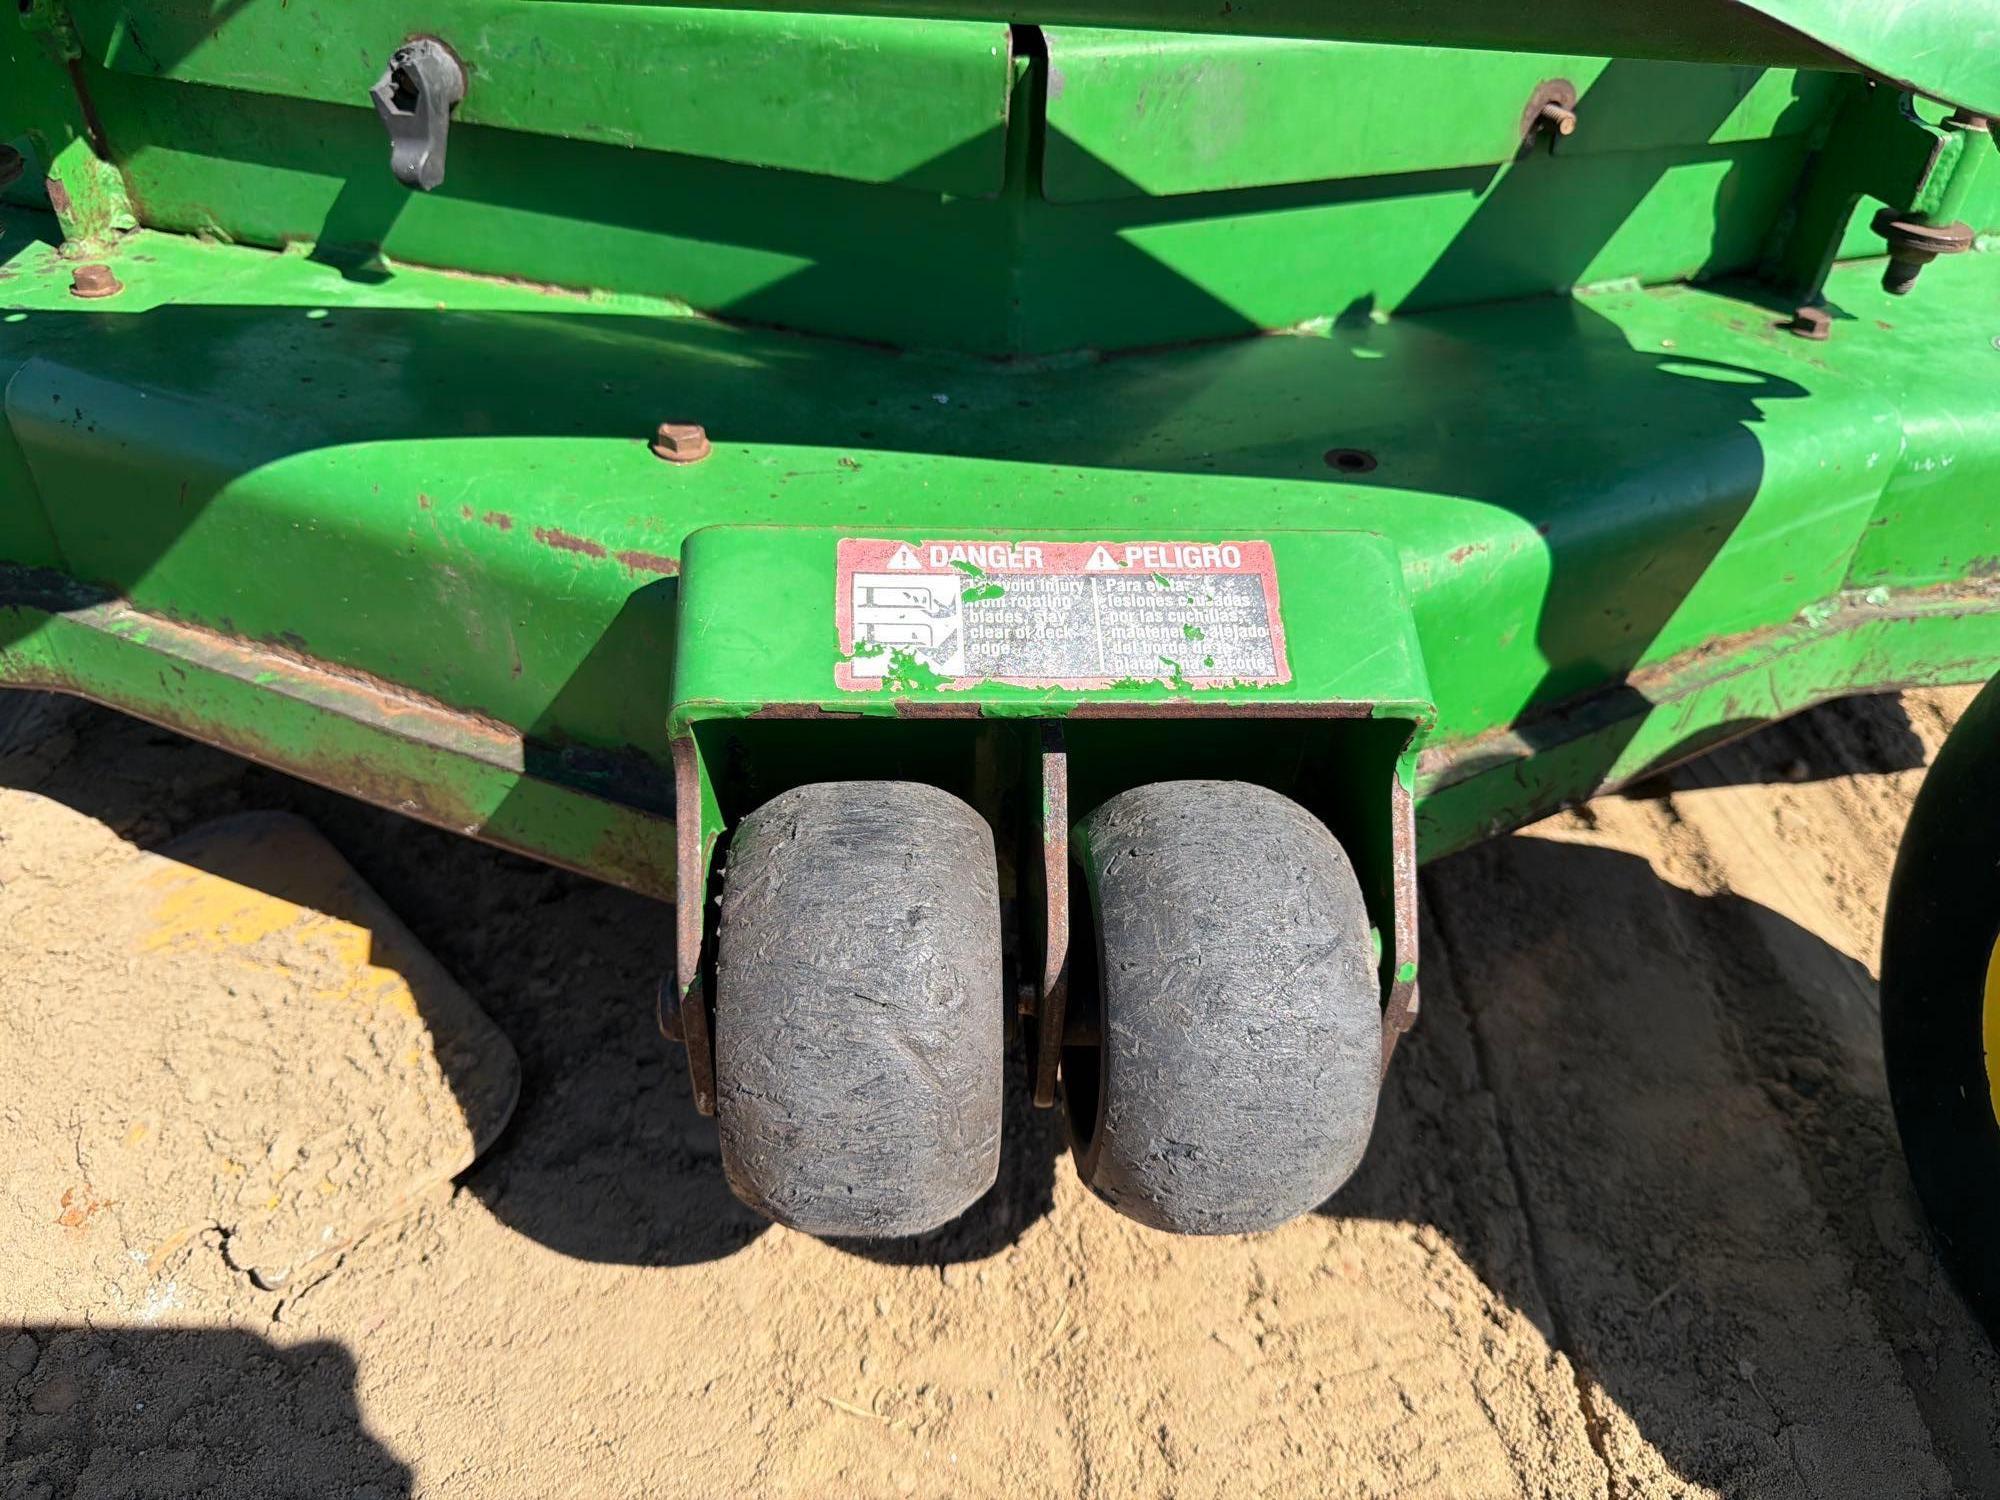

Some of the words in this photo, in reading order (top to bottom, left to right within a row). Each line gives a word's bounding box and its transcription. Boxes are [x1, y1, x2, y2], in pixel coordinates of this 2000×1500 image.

[929, 545, 1043, 569] DANGER
[1125, 545, 1242, 569] PELIGRO
[990, 578, 1034, 592] void
[1038, 577, 1085, 597] injury
[1106, 578, 1141, 592] Para
[1010, 594, 1071, 612] rotating
[1108, 593, 1174, 608] lesiones
[1178, 593, 1250, 608] cusadas
[970, 624, 1010, 639] clear
